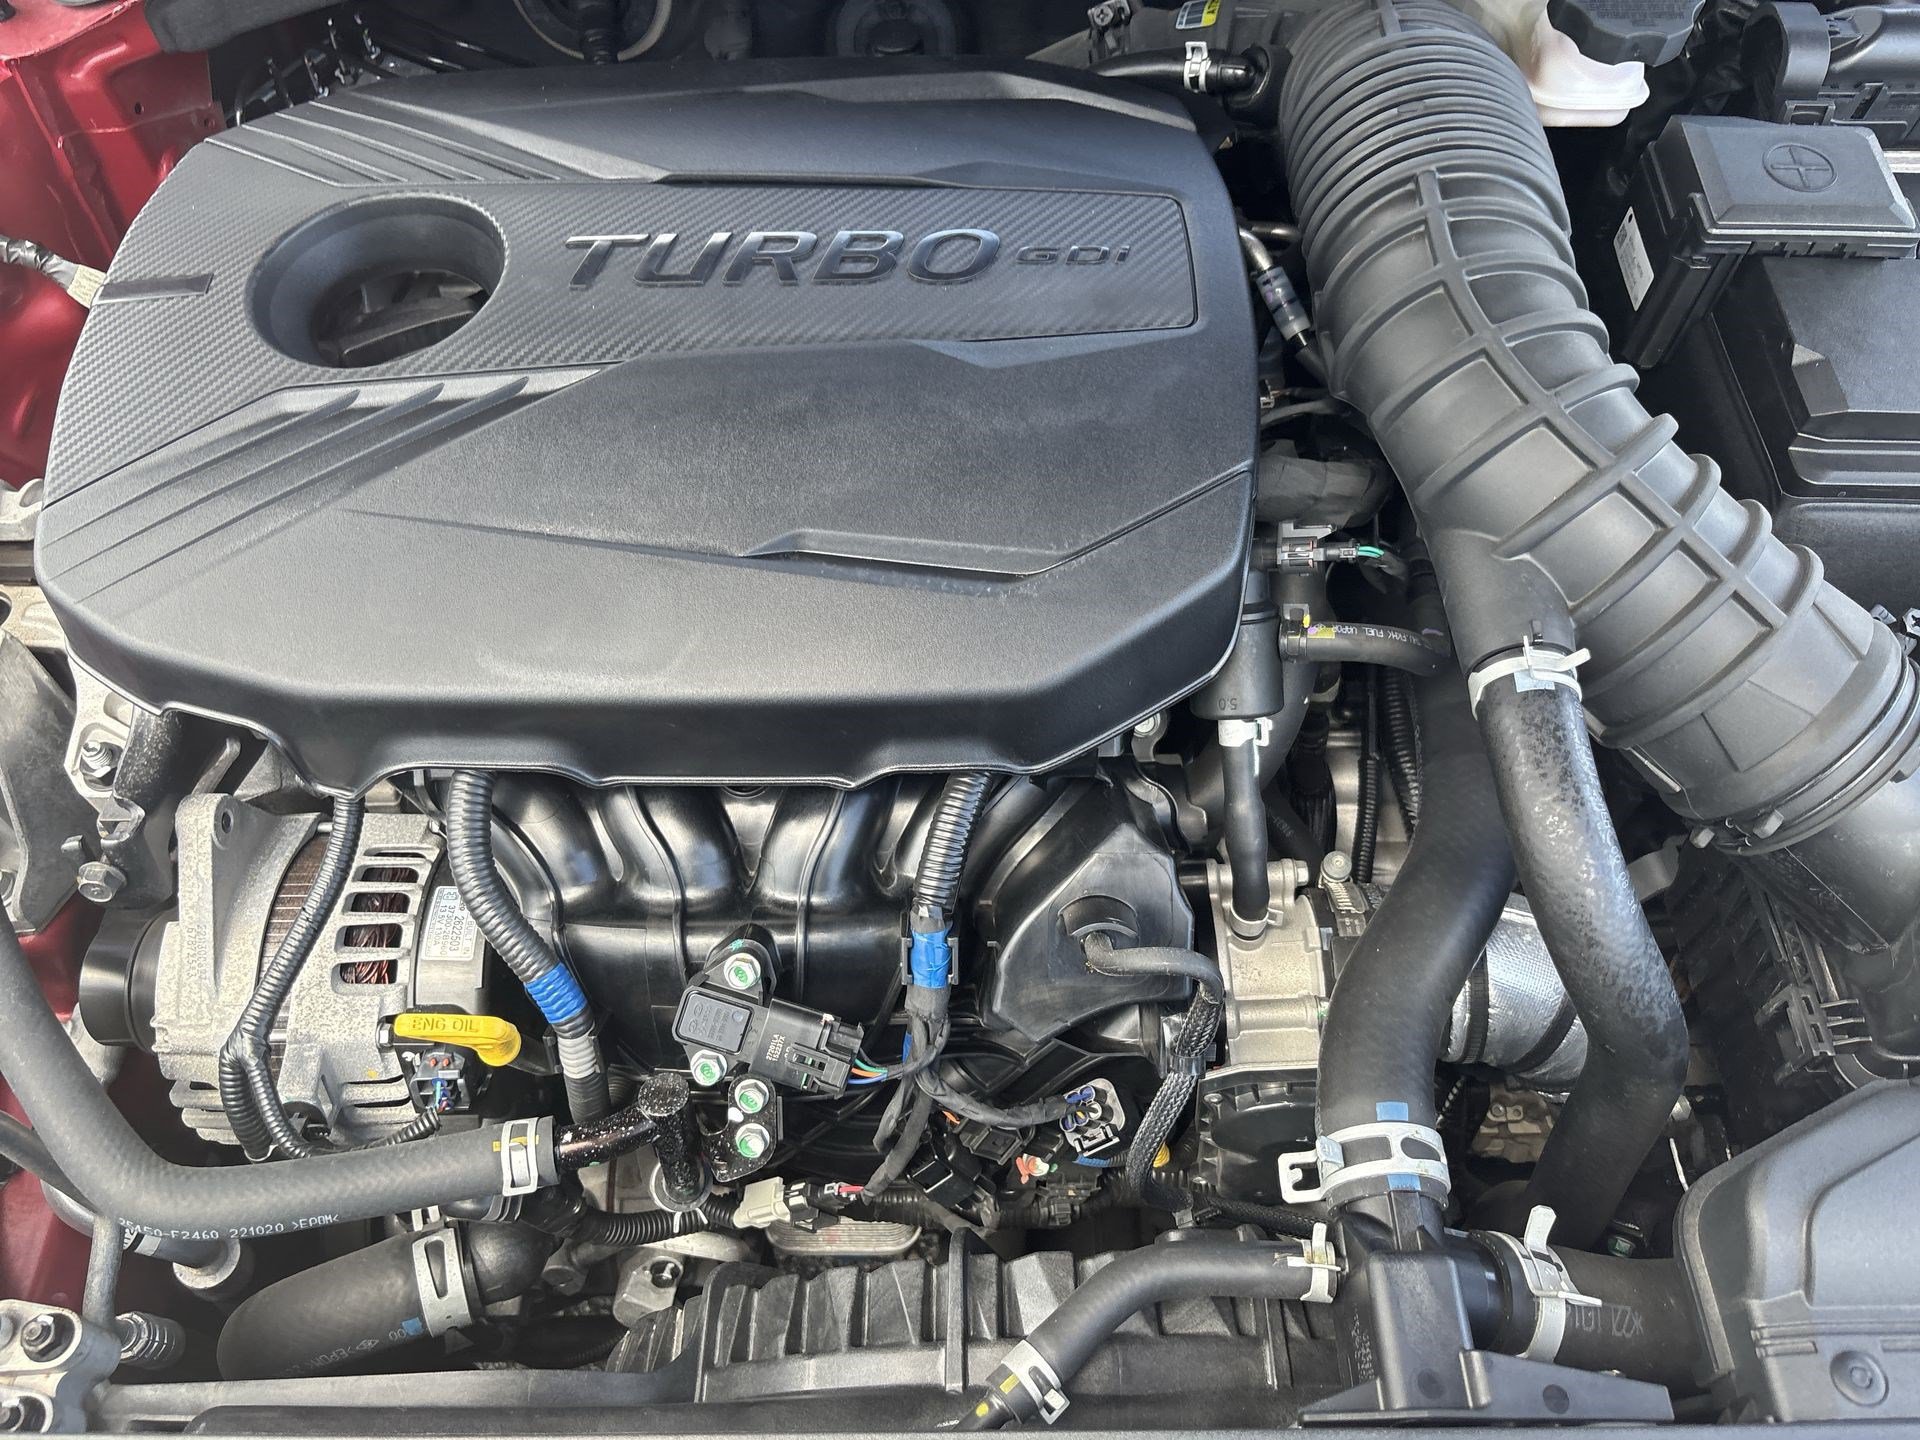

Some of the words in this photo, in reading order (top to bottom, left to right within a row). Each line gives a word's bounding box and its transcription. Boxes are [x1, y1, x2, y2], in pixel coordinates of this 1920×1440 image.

[564, 228, 1001, 290] TURBO
[1362, 626, 1385, 638] FUEL
[449, 915, 465, 952] 2622503
[412, 1017, 446, 1031] ENG
[452, 1018, 479, 1033] OIL
[229, 1223, 284, 1239] 221020
